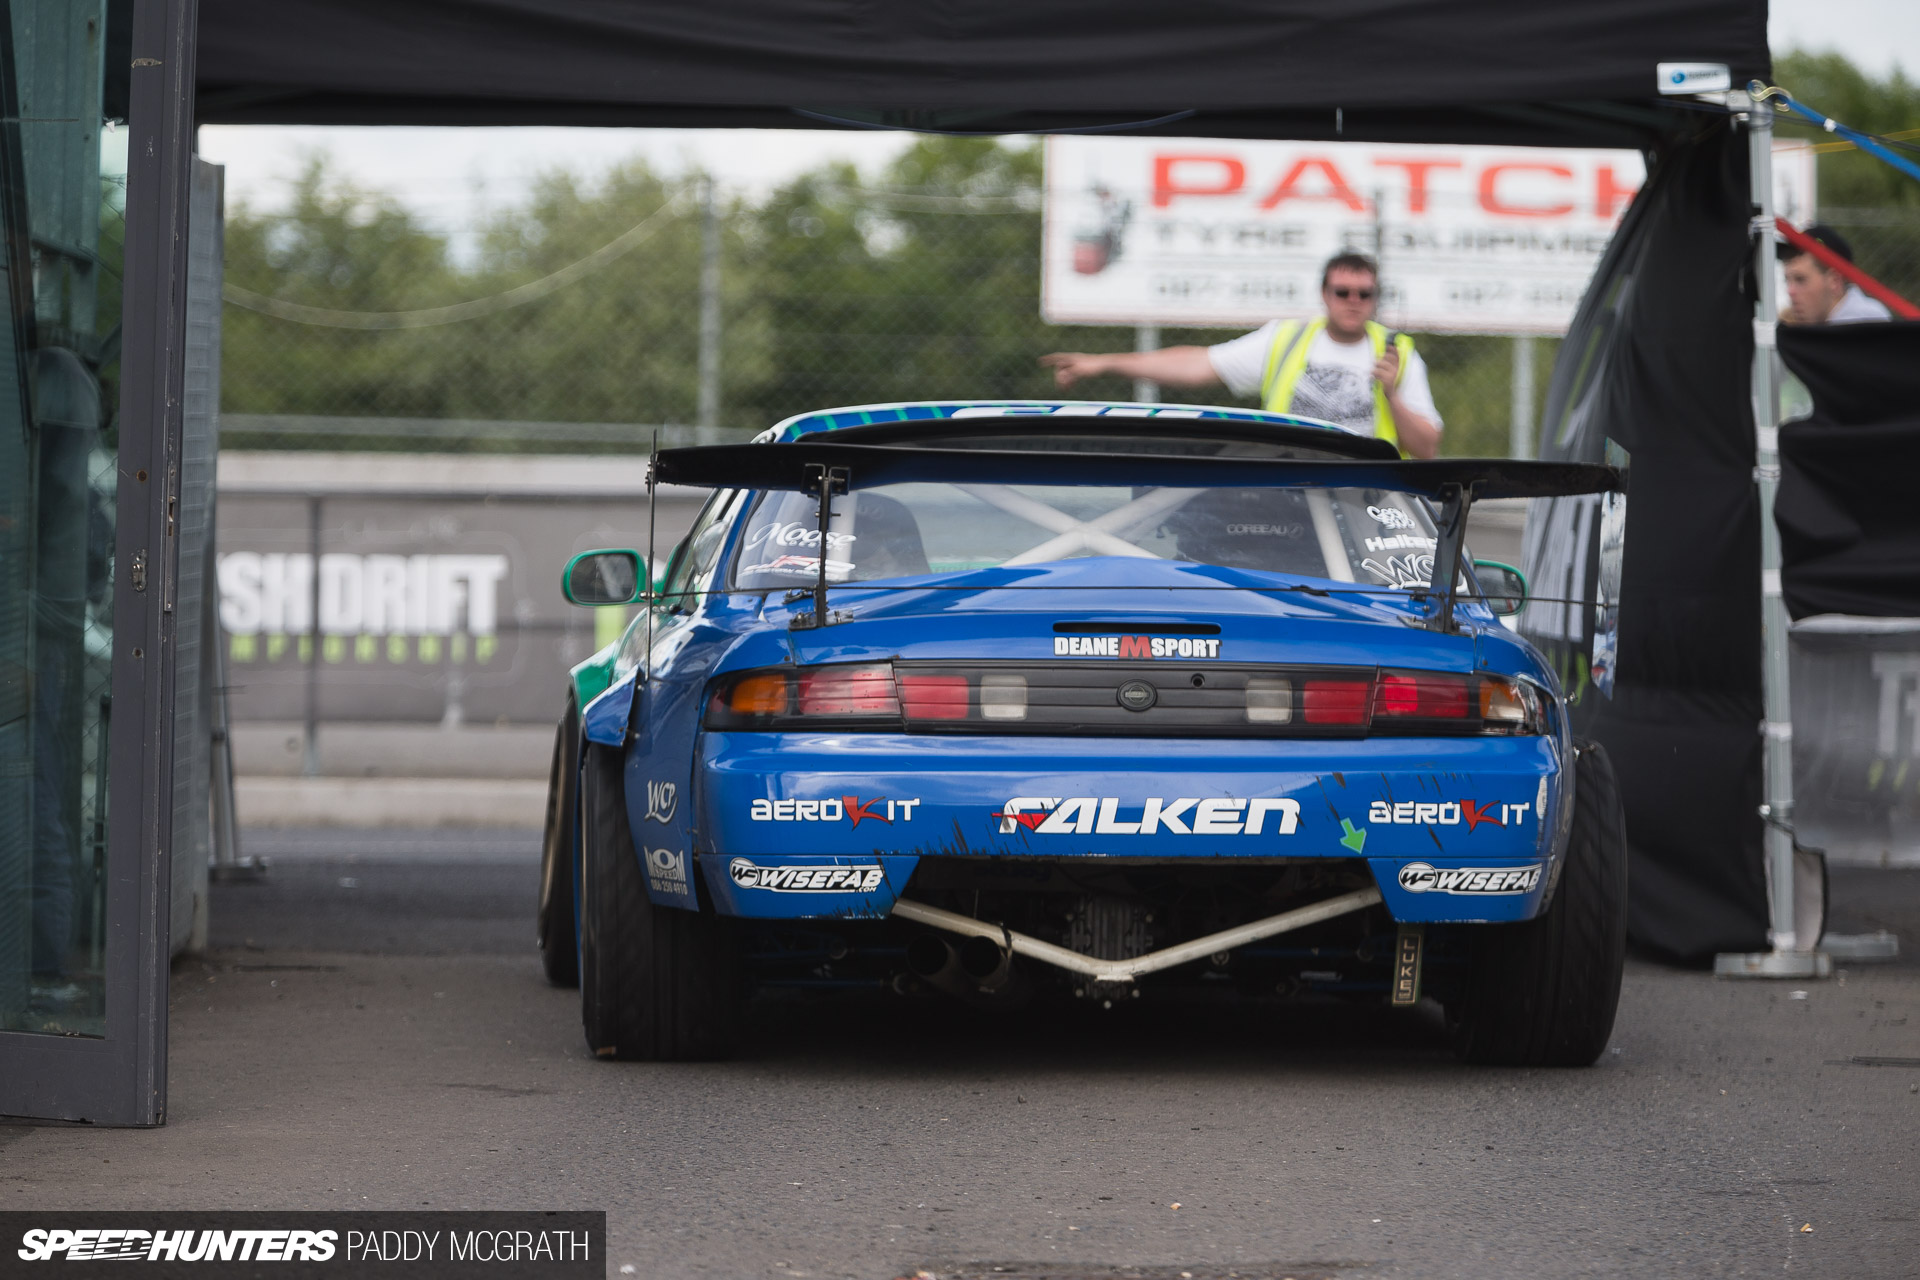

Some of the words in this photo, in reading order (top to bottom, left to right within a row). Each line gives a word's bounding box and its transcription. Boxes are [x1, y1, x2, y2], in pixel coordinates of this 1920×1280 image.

[1226, 522, 1288, 536] CORBEAU
[1361, 553, 1436, 590] WC
[217, 551, 314, 634] SH
[318, 553, 508, 635] DRIFT
[991, 797, 1301, 835] FALKEN
[760, 869, 884, 889] WISEFAB
[1437, 867, 1542, 892] WISEFAB
